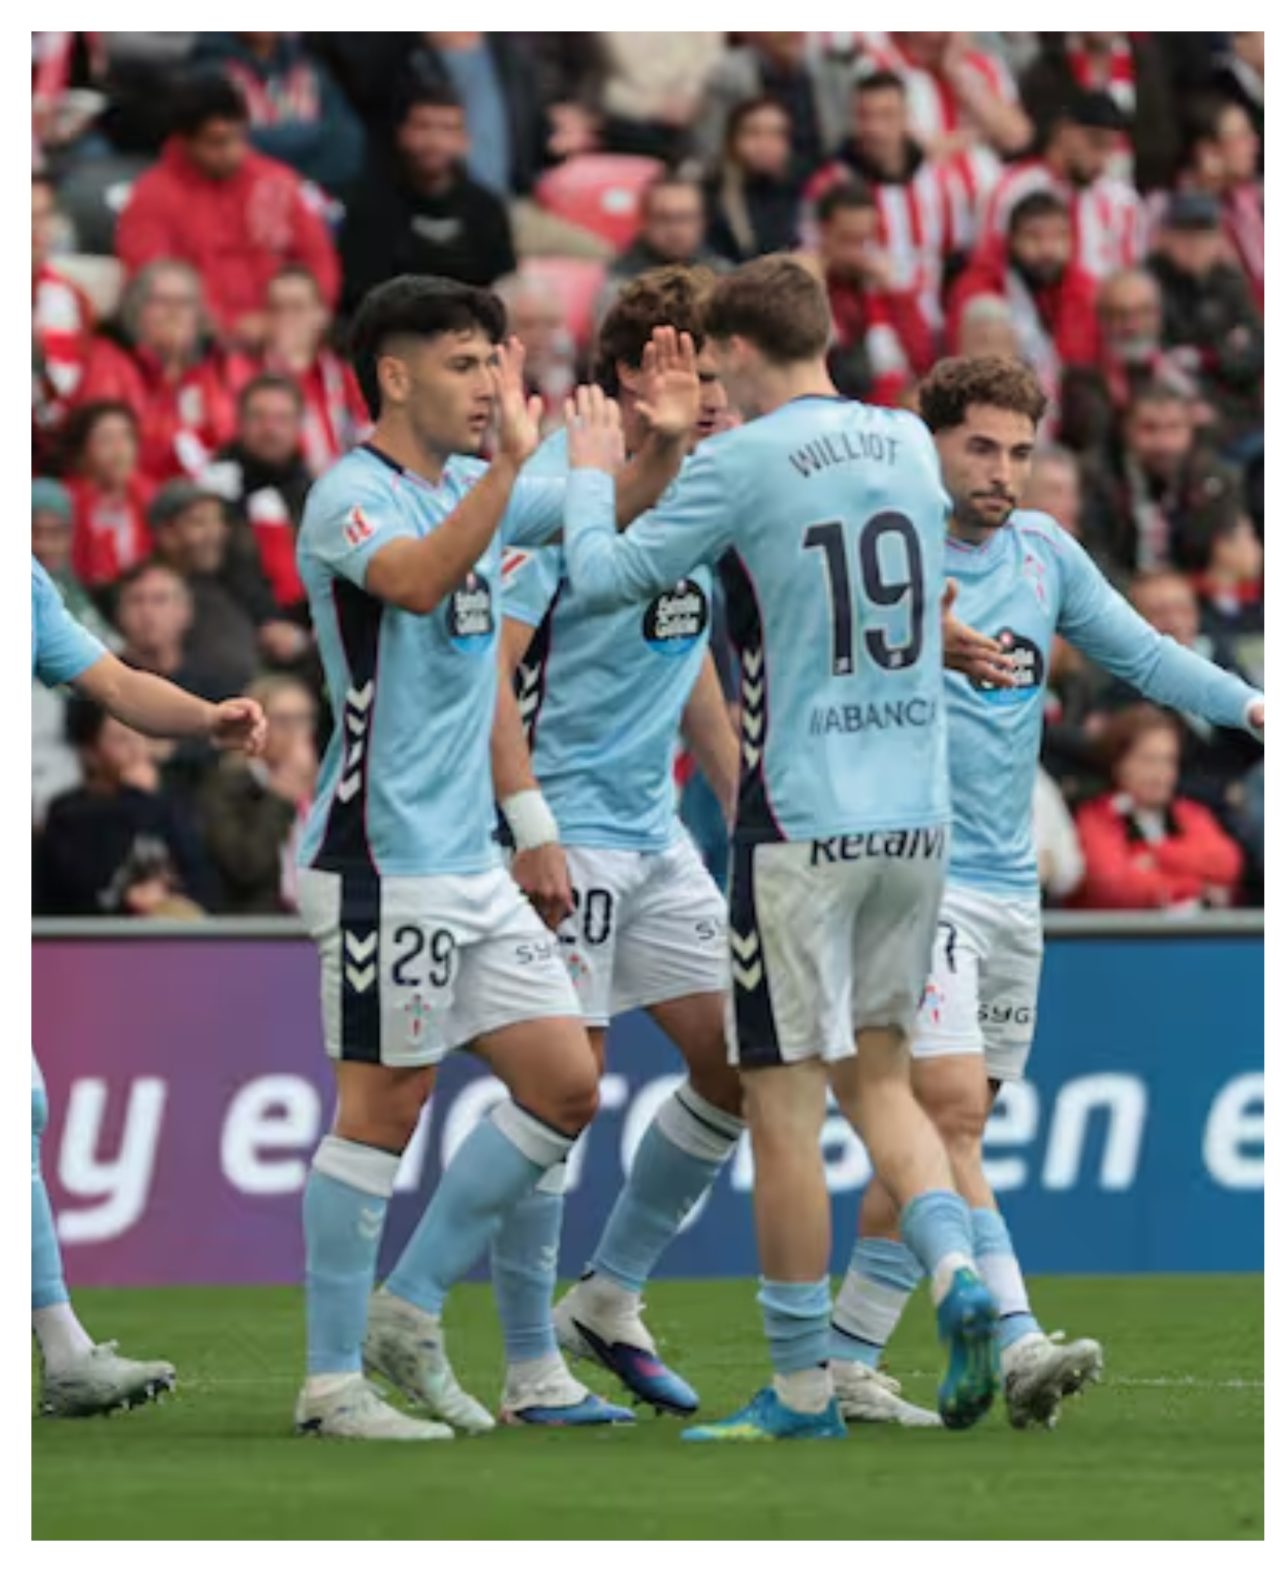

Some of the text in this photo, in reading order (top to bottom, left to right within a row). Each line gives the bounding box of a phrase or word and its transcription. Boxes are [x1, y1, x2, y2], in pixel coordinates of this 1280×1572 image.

[788, 431, 899, 478] WILLIOT
[803, 511, 924, 676] 19
[393, 925, 456, 987] 29
[54, 1075, 166, 1244] y
